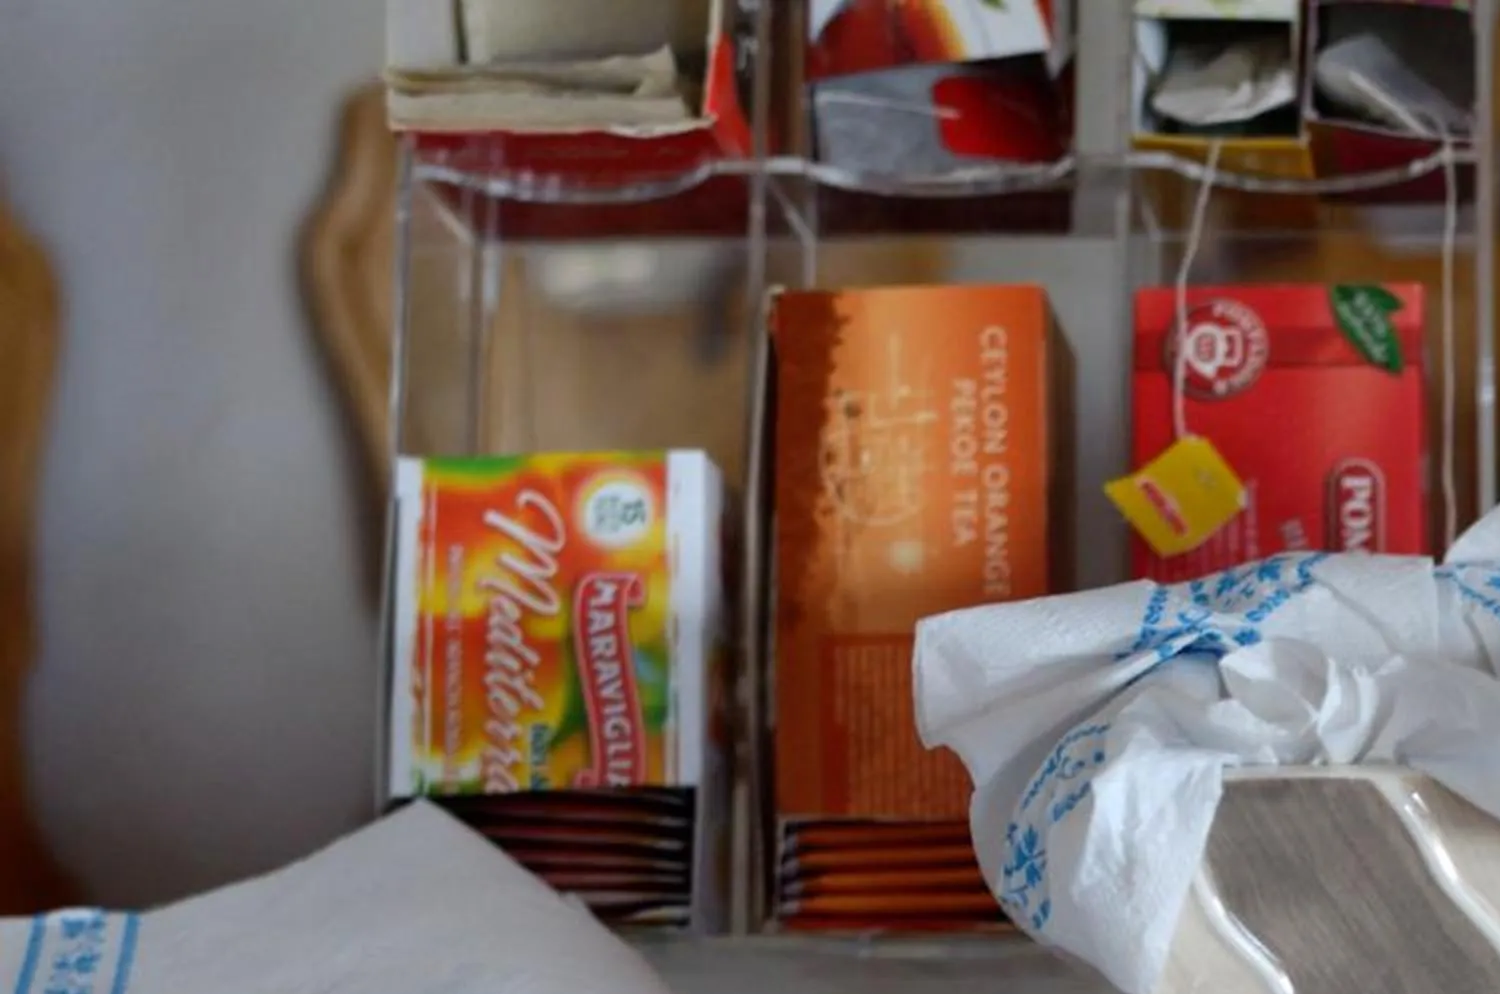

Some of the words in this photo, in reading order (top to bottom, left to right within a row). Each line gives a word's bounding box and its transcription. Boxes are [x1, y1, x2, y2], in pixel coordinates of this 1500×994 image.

[950, 377, 977, 476] PEKOE
[978, 325, 1008, 456] CEYLON
[621, 498, 646, 525] 15
[952, 489, 977, 547] TEA
[983, 464, 1011, 598] ORANGE
